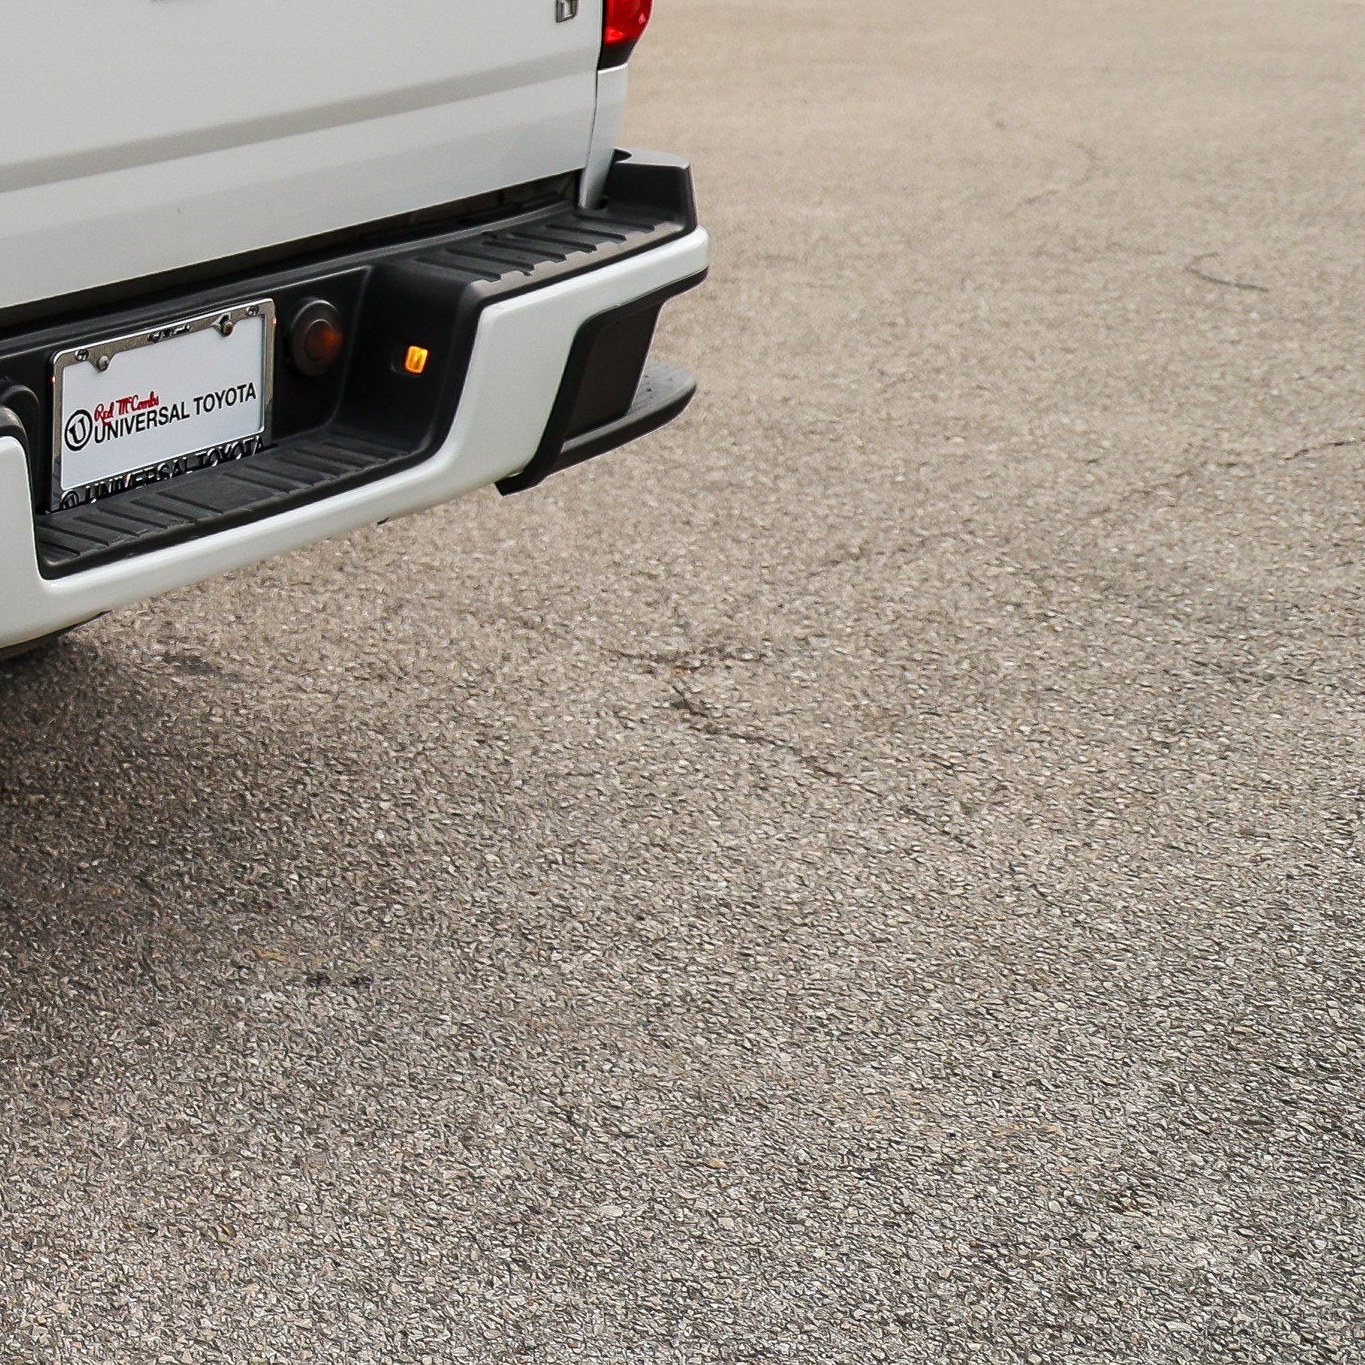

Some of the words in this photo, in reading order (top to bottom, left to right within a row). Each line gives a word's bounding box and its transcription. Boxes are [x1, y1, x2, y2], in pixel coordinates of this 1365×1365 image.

[94, 401, 191, 444] UNIVERSAL
[193, 382, 257, 415] TOYOTA
[85, 456, 193, 504] UNIVERSAL
[195, 435, 264, 468] TOYOTA
